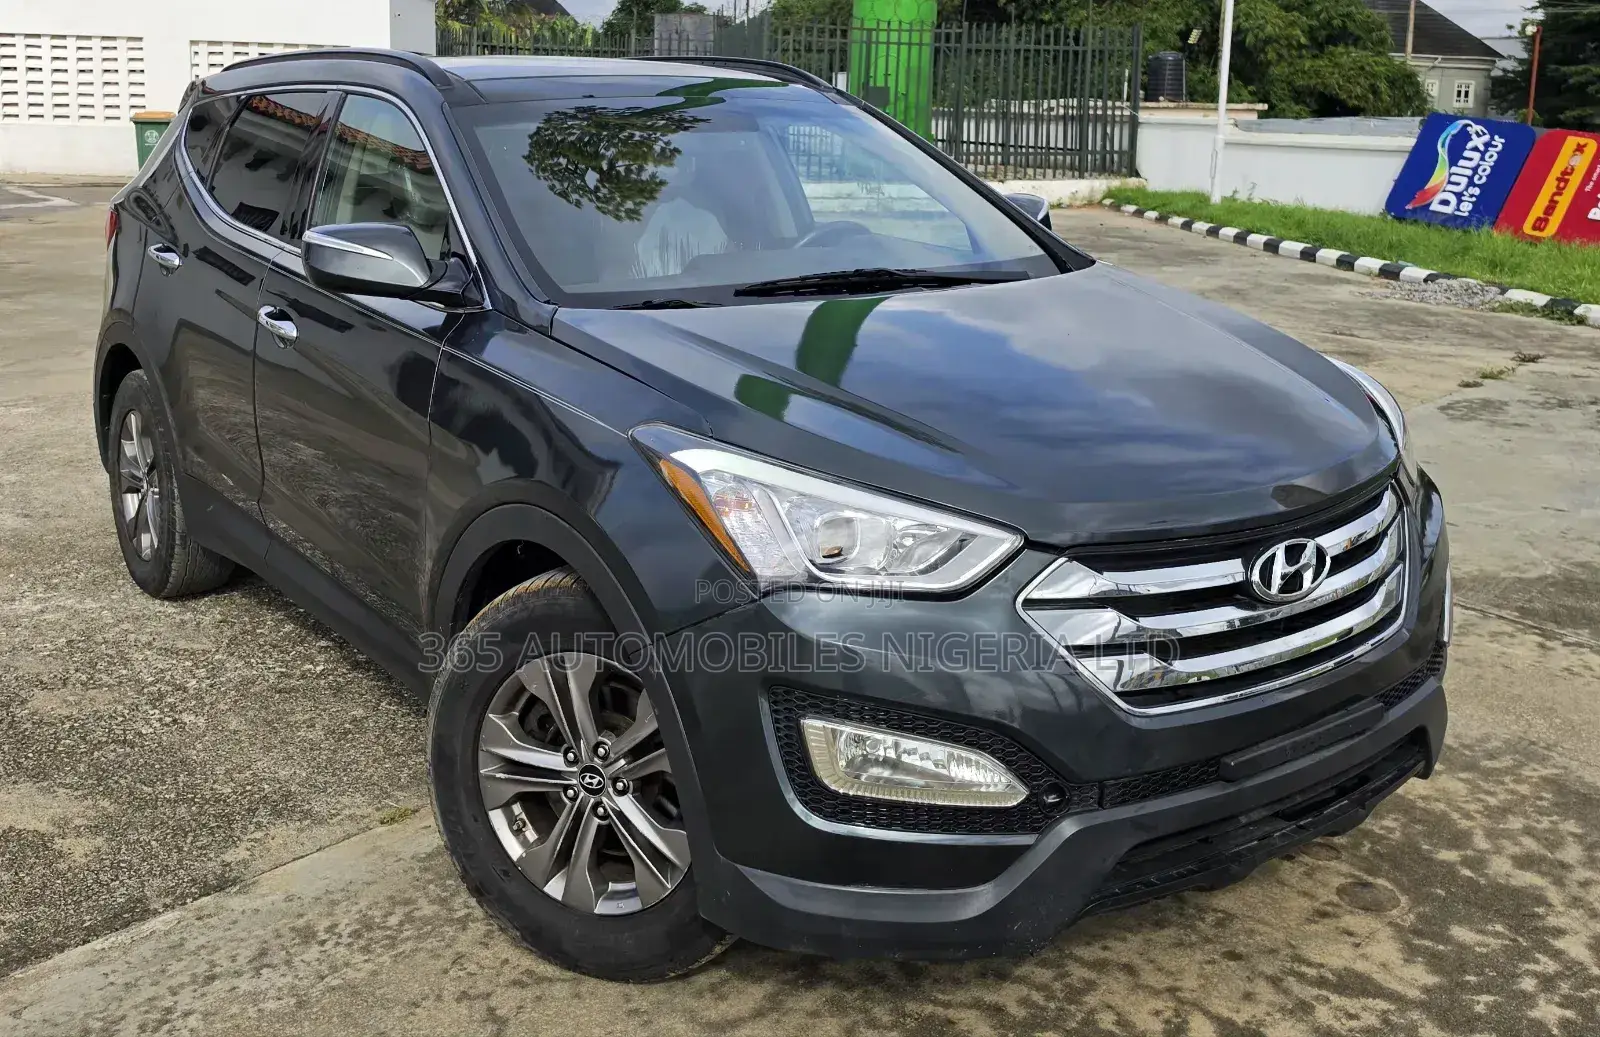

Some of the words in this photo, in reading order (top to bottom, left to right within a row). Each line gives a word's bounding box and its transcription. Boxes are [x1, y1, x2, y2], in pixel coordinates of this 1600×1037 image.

[1429, 126, 1490, 214] Dulux
[1454, 186, 1480, 216] let's
[1474, 135, 1505, 184] colour
